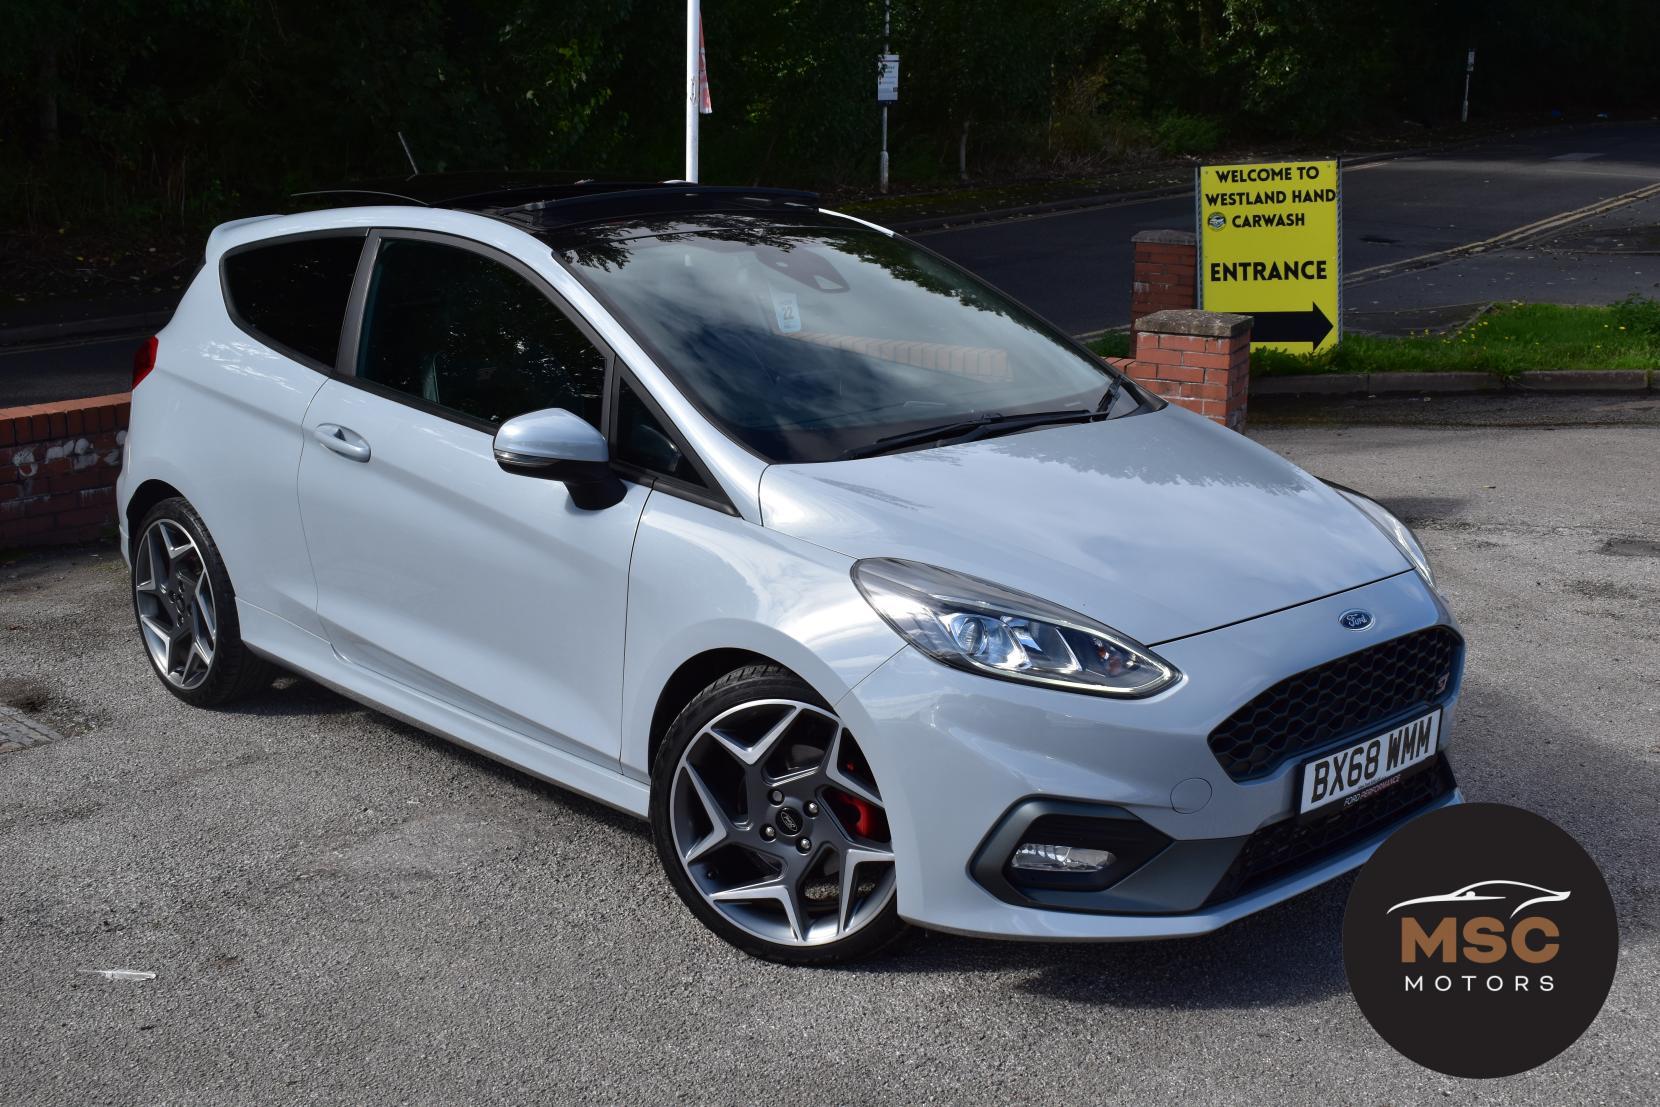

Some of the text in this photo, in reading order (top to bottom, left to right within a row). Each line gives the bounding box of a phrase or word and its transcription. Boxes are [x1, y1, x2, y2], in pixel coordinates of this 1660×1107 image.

[1216, 166, 1320, 183] WELCOME TO
[1205, 189, 1336, 207] WESTLAND HAND
[1231, 213, 1305, 228] CARWASH
[1210, 260, 1327, 282] ENTRANCE
[1311, 716, 1433, 804] BX68 WMM
